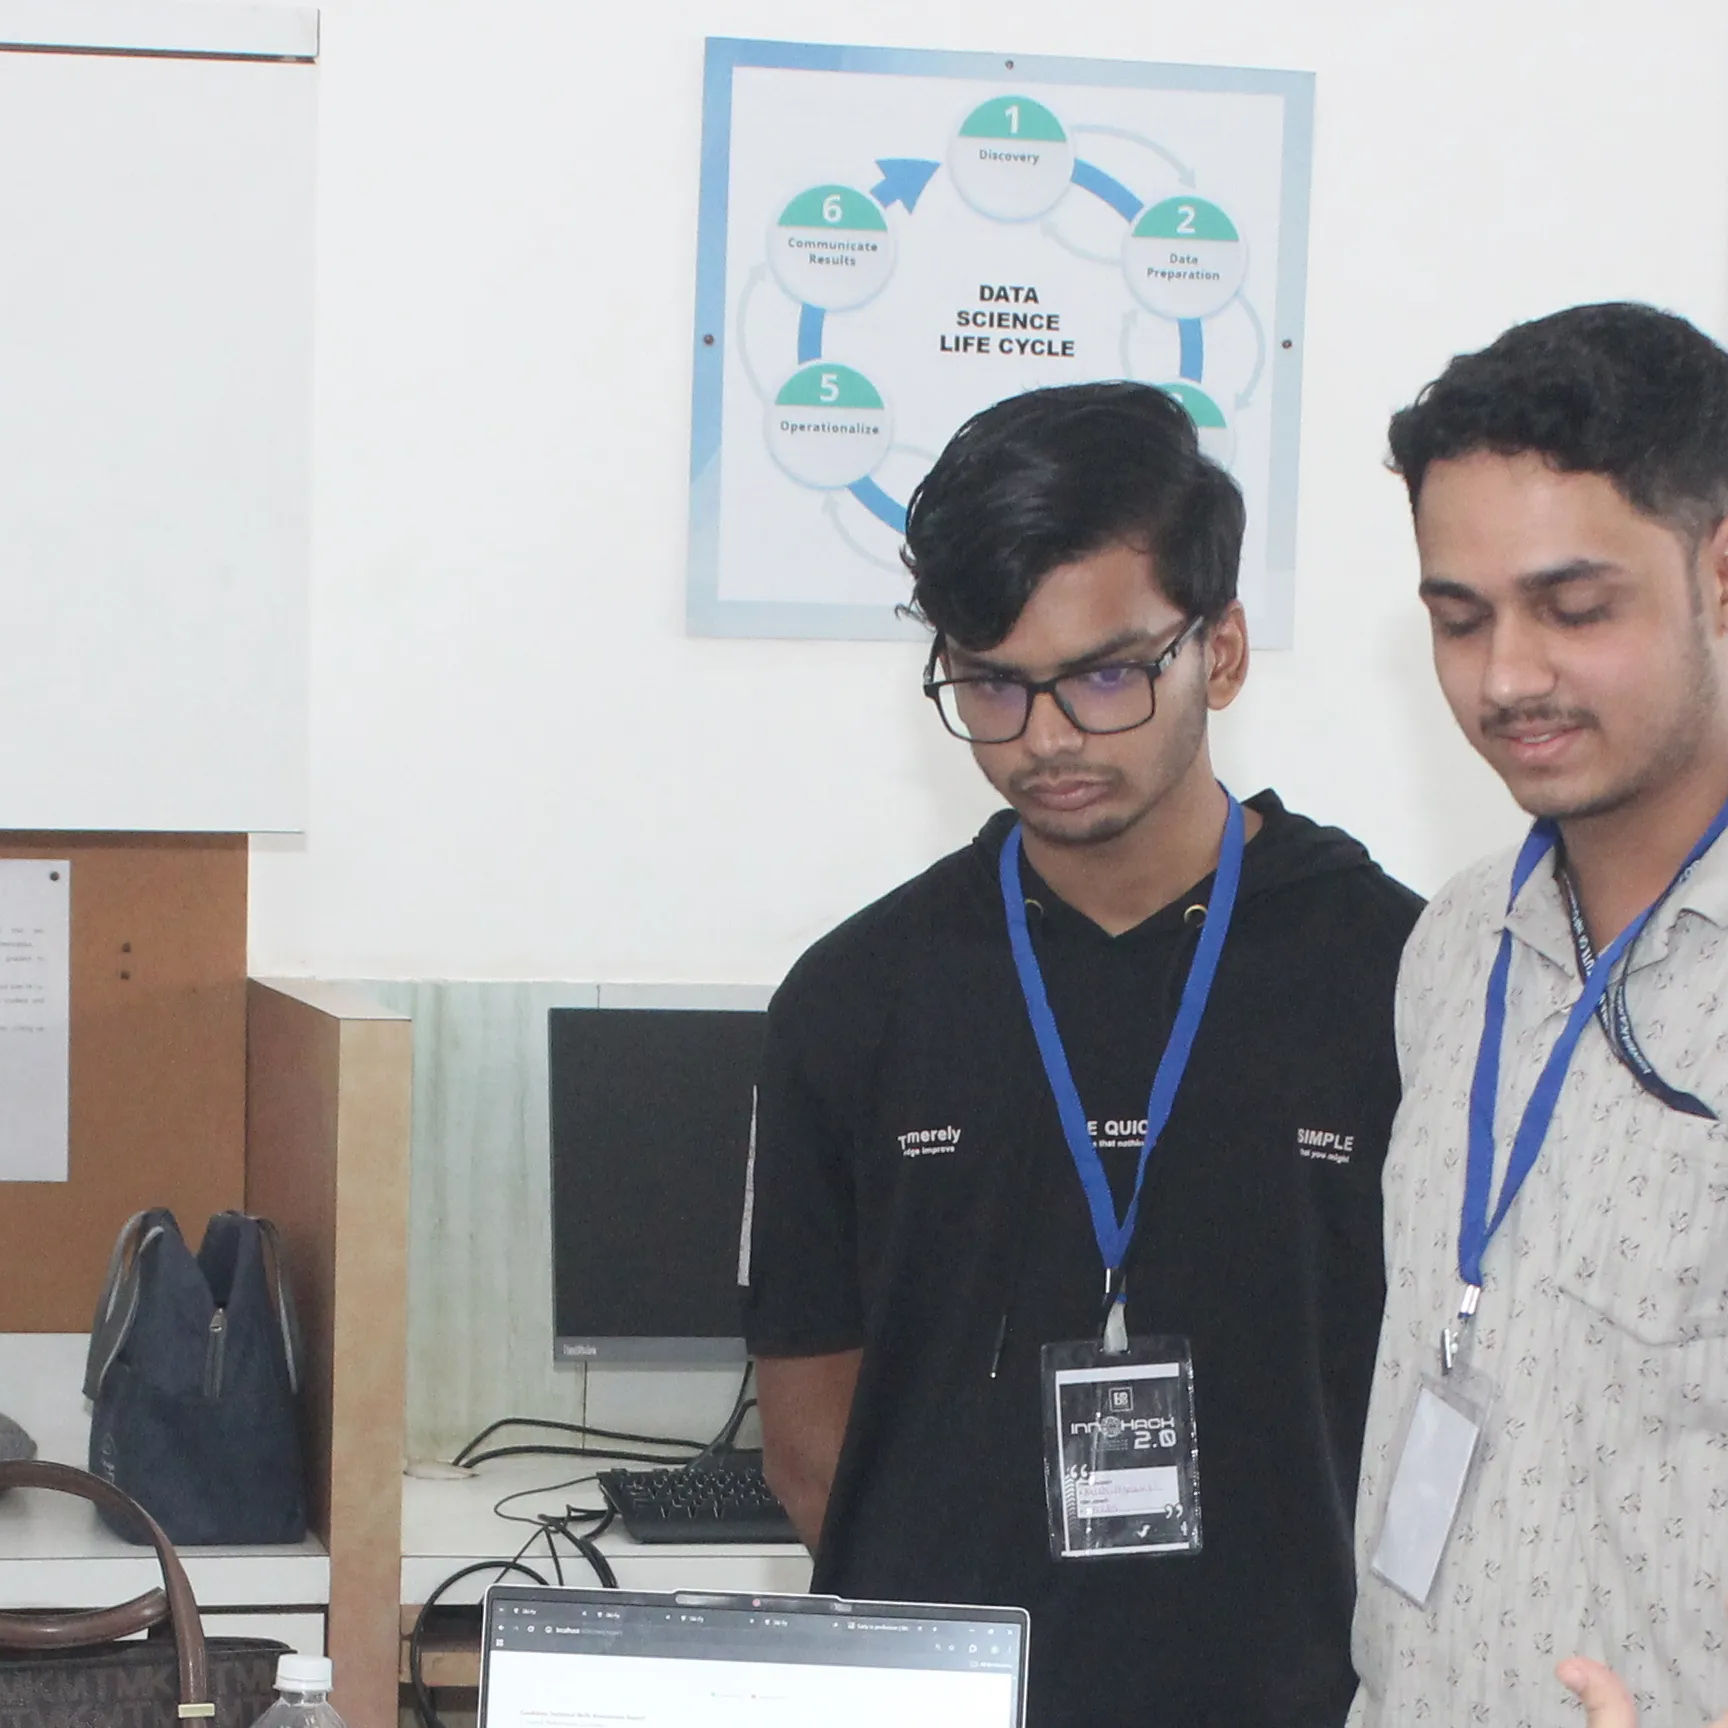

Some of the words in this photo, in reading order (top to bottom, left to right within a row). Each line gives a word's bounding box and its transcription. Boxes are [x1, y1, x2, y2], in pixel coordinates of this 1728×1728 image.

[1004, 106, 1020, 133] 1
[979, 149, 1039, 165] Discovery
[822, 196, 843, 223] 6
[1176, 207, 1196, 233] 2
[787, 238, 878, 253] Communicate
[809, 254, 856, 268] Results
[1168, 254, 1198, 266] Data
[1147, 266, 1220, 282] Preparation
[979, 285, 1038, 304] DATA
[956, 310, 1060, 331] SCIENCE
[939, 335, 990, 356] LIFE
[998, 337, 1075, 358] CYCLE
[820, 374, 839, 401] 5
[780, 420, 880, 436] Operationalize
[1297, 1128, 1354, 1152] SIMPLE
[1134, 1429, 1177, 1450] 2.0
